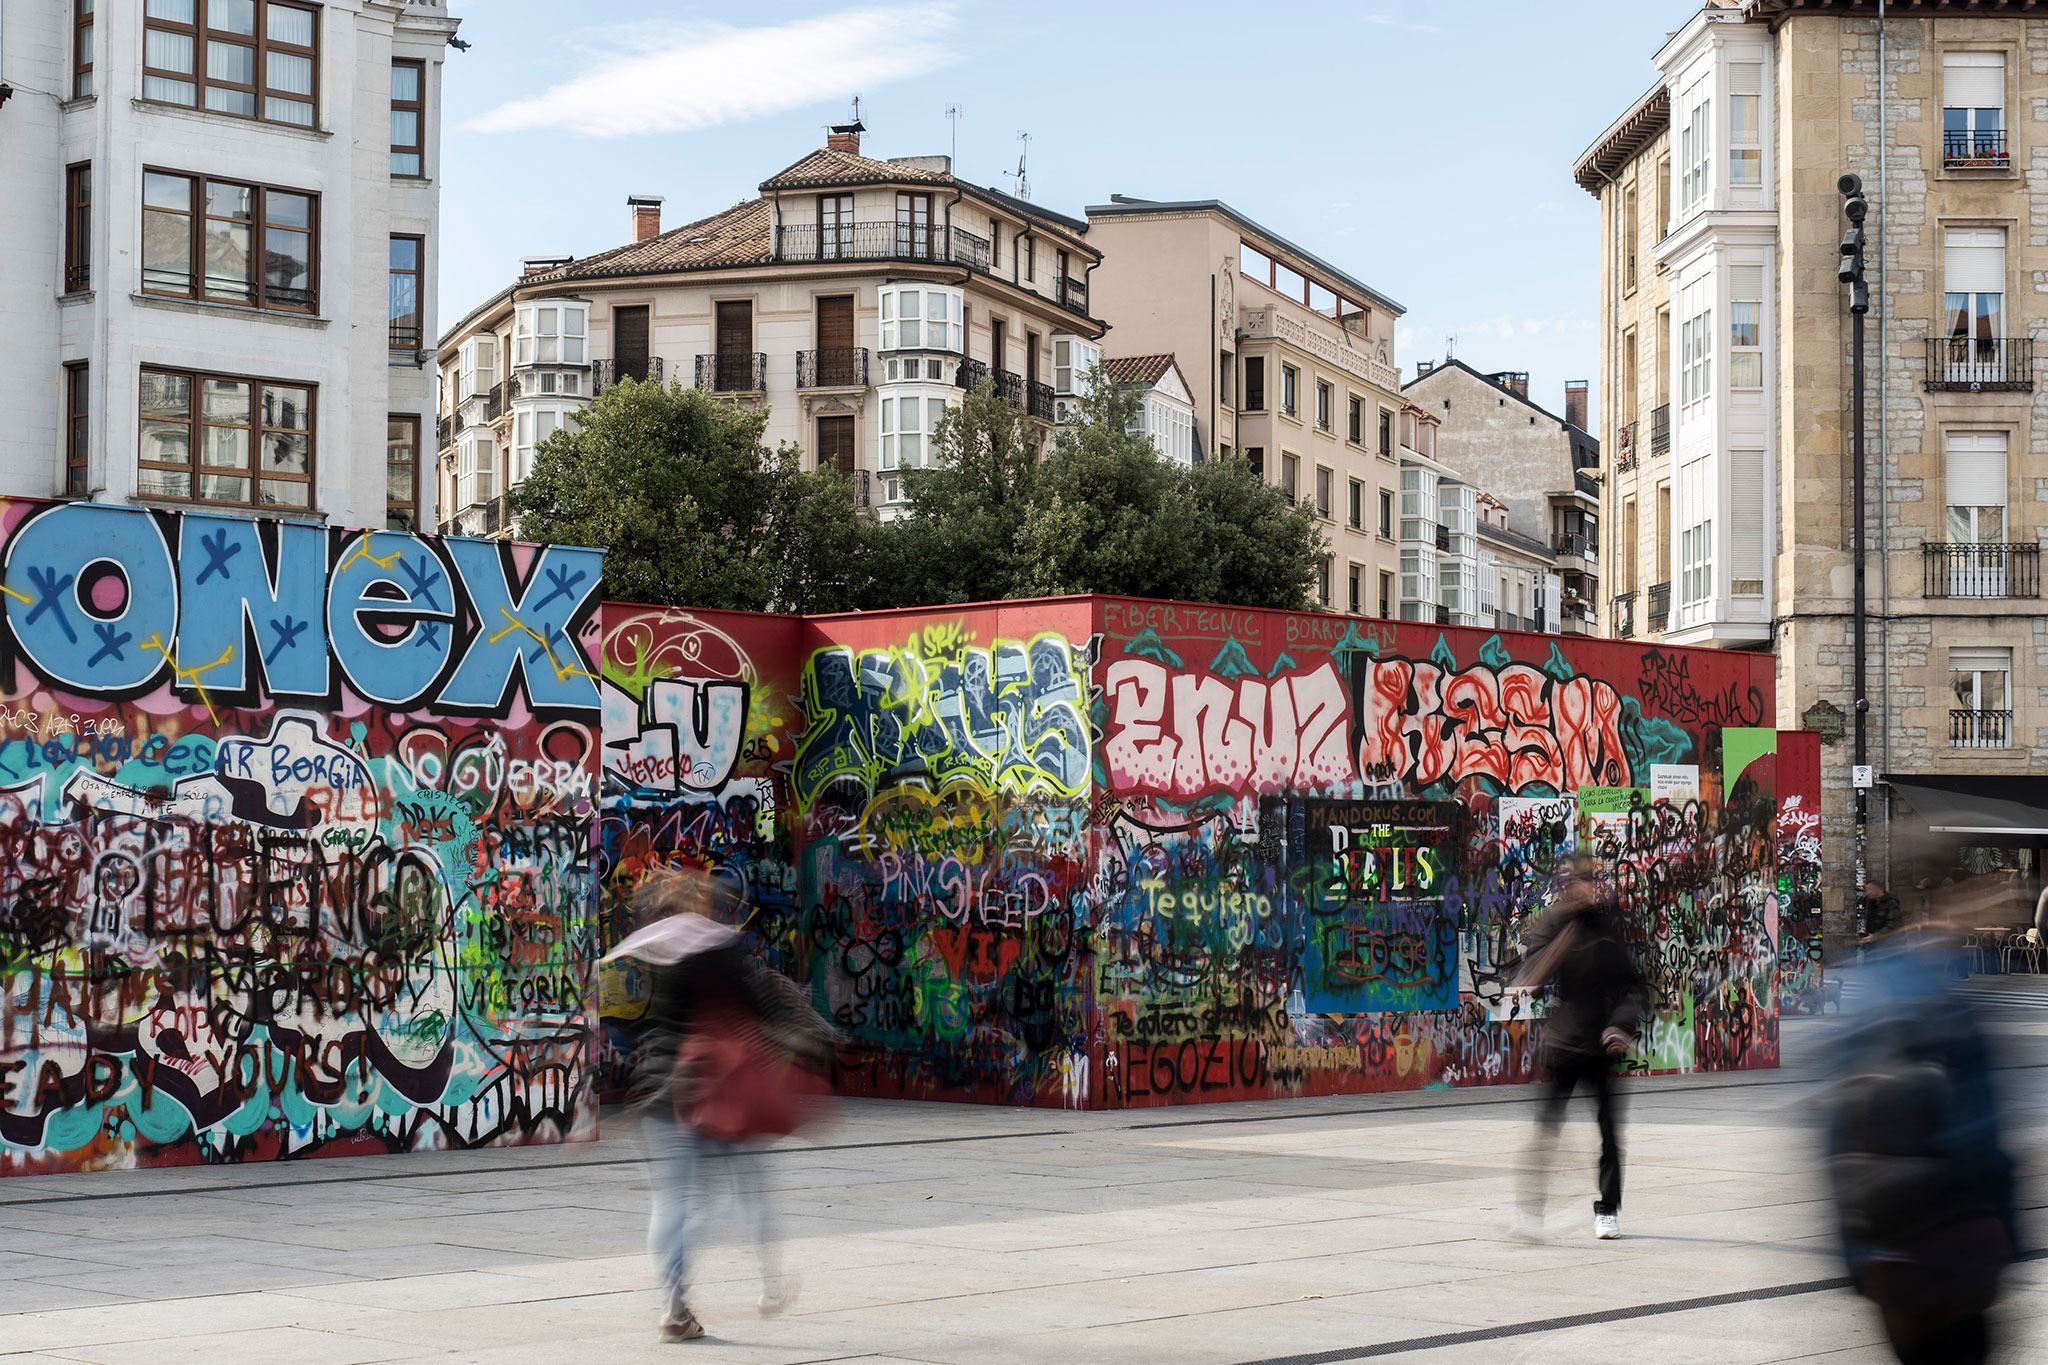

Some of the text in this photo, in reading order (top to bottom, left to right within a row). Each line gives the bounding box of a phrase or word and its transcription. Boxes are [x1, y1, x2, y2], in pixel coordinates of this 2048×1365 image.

[1103, 602, 1398, 645] FIBERTECNIC BORROKAN
[1640, 648, 1690, 685] FREE
[1637, 678, 1756, 725] PALESTINA
[384, 747, 590, 799] NO GUERRA
[1311, 805, 1438, 829] MANDOKUS.COM
[1371, 823, 1391, 838] THE
[1328, 825, 1433, 902] BEATLES
[879, 851, 936, 915] PINK
[936, 856, 1049, 931] SHEEP
[1140, 878, 1272, 927] Te quiero
